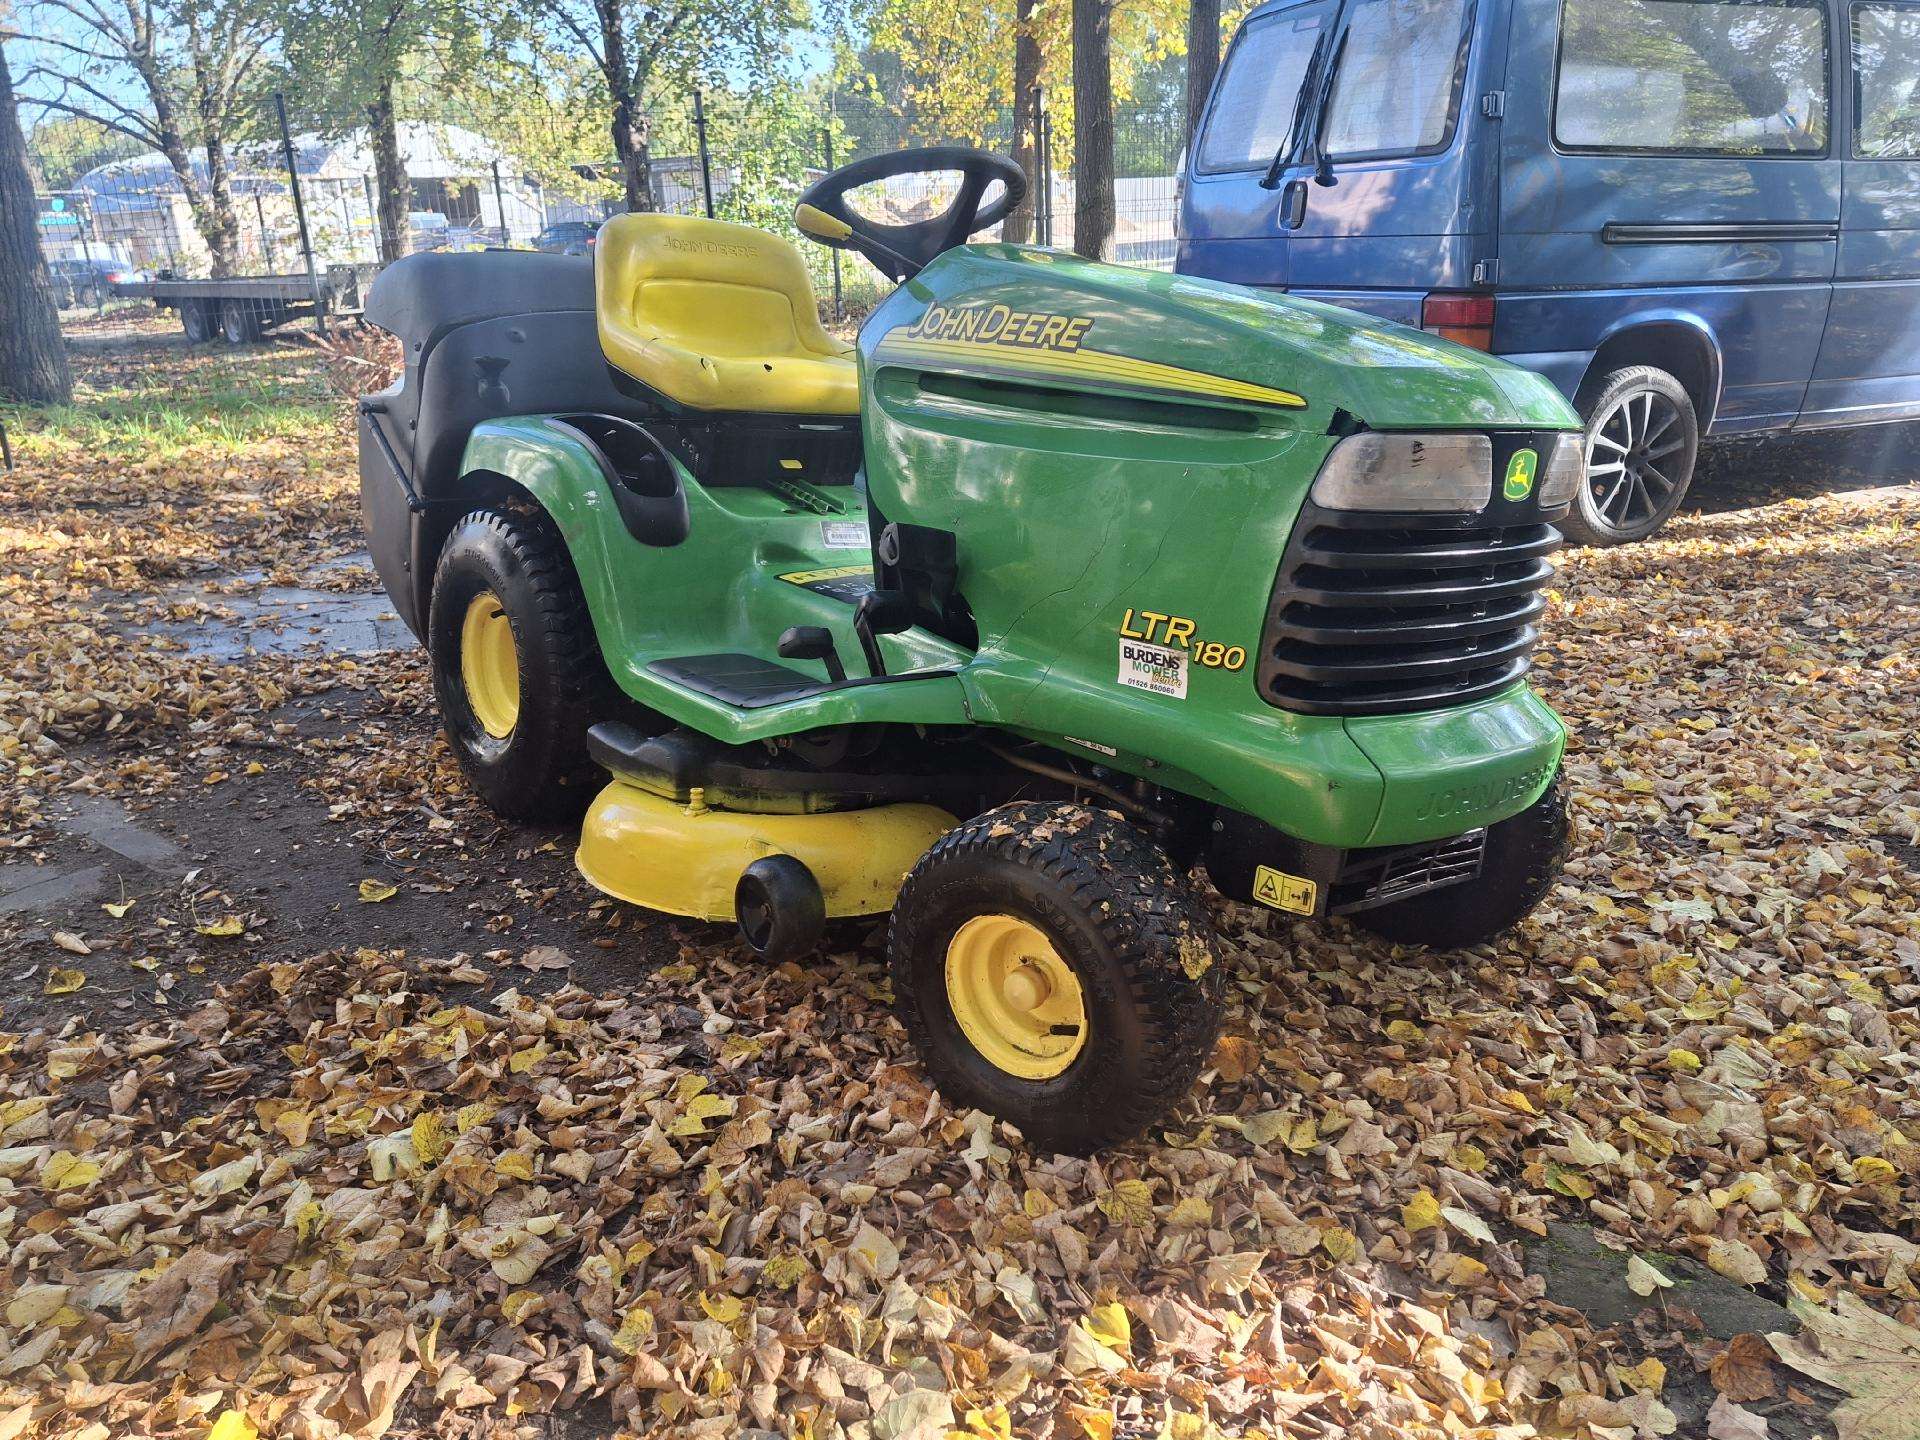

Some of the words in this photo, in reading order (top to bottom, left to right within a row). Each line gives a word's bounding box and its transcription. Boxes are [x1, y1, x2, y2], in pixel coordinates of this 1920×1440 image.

[663, 234, 703, 254] JOHN
[705, 240, 759, 259] DEERE
[907, 301, 984, 343] JOHN
[976, 303, 1096, 353] DEERE
[1120, 608, 1197, 651] LTR
[1192, 640, 1248, 672] 180
[1123, 645, 1181, 670] BURDENS
[1132, 661, 1180, 681] MOWER
[1151, 671, 1183, 689] Centre
[1127, 677, 1149, 690] 01526
[1149, 683, 1176, 696] 860060
[1416, 780, 1495, 821] JOHN
[1499, 757, 1557, 805] DEERE
